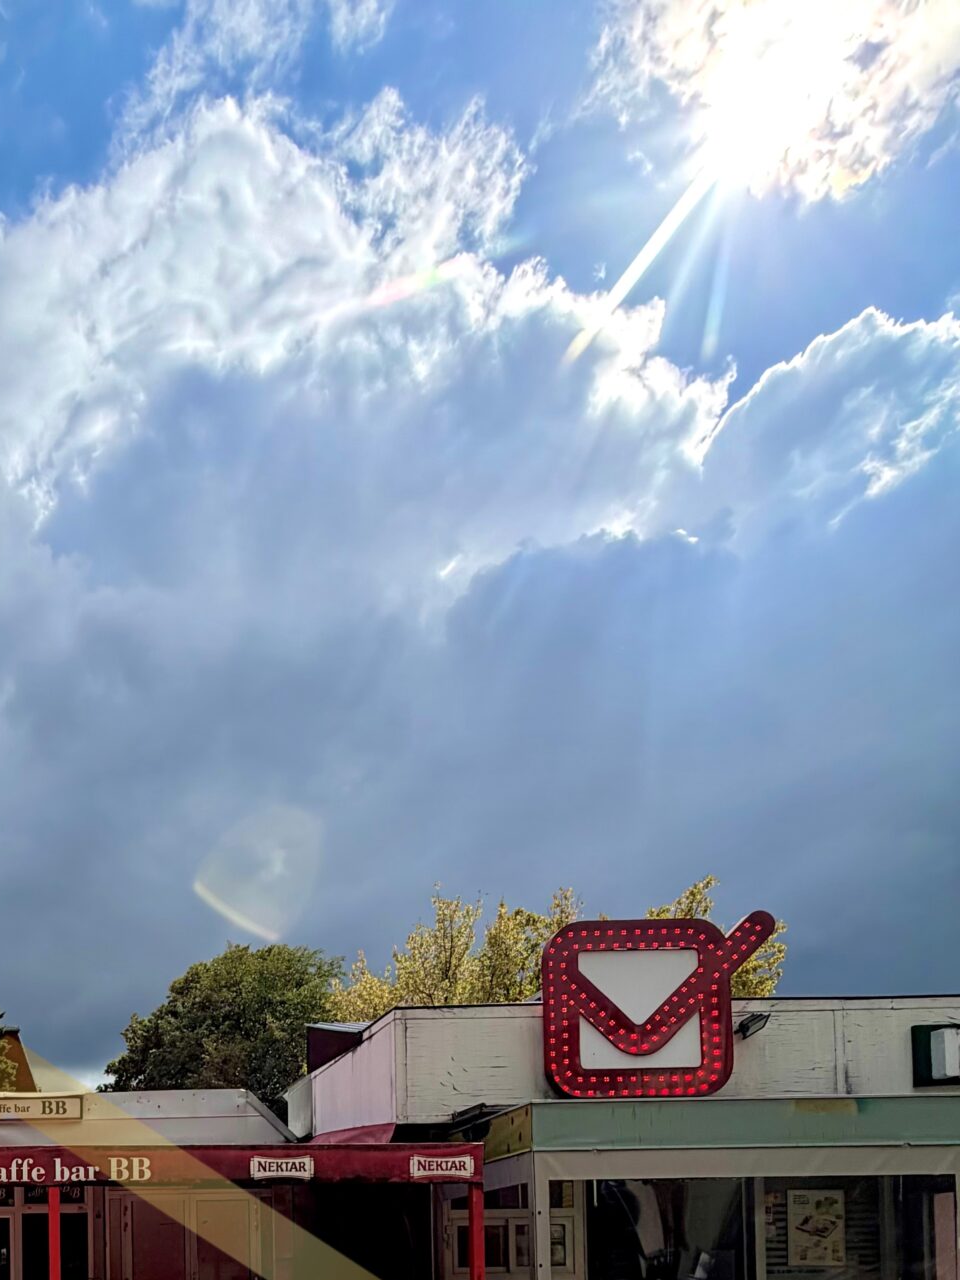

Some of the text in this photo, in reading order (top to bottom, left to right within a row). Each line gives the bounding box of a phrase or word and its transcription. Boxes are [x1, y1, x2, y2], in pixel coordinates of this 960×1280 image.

[14, 1103, 30, 1113] bar
[40, 1100, 67, 1115] BB
[53, 1158, 100, 1182] bar
[108, 1157, 152, 1182] BB
[257, 1160, 307, 1173] NEKTAR
[417, 1159, 466, 1172] NEKTAR
